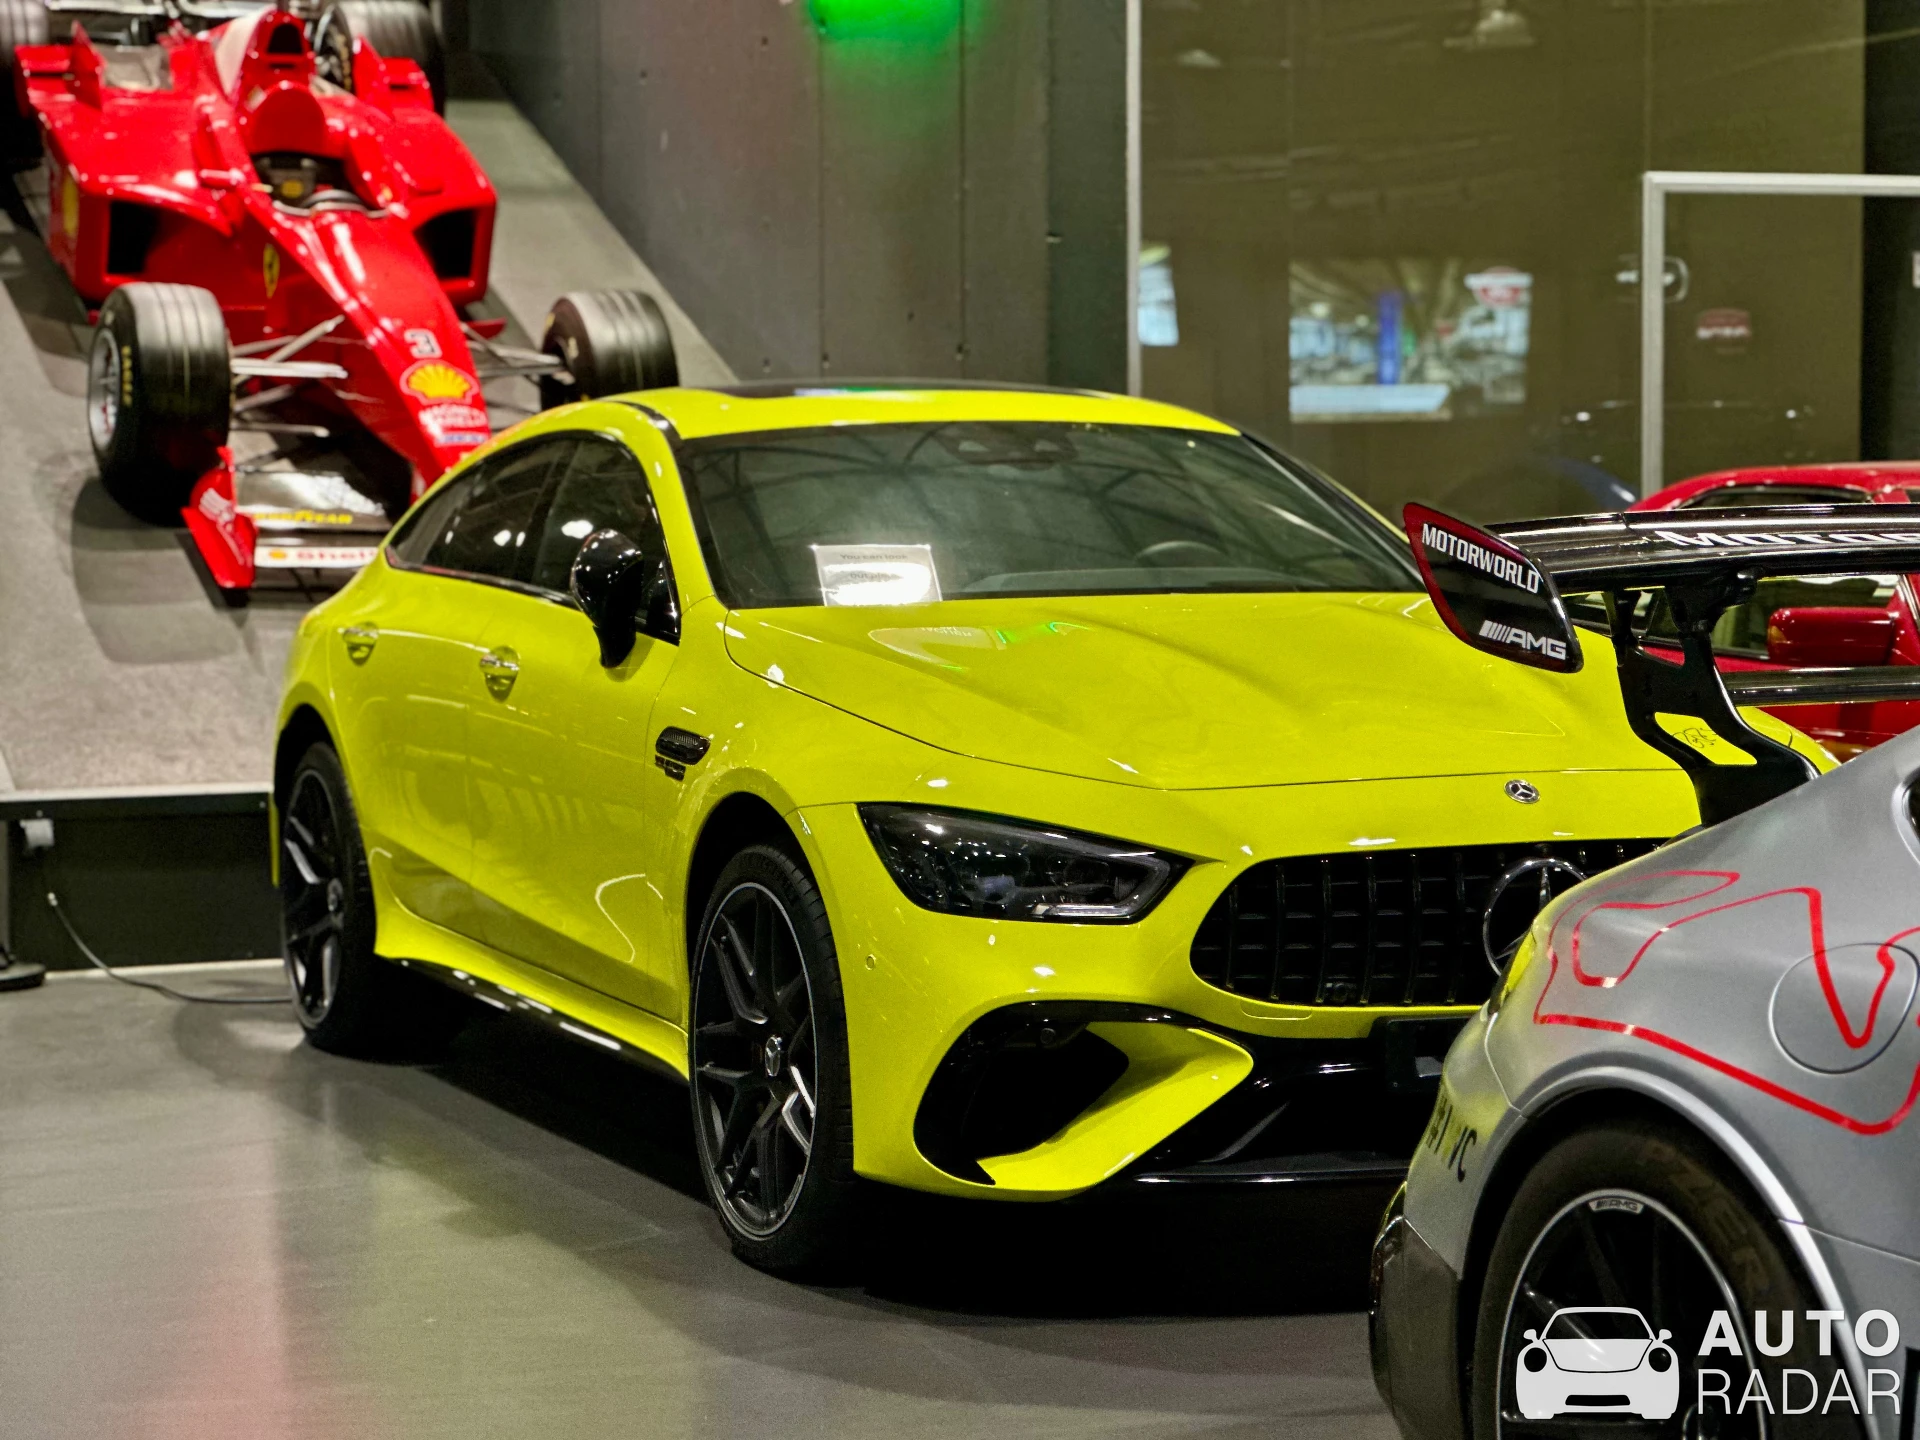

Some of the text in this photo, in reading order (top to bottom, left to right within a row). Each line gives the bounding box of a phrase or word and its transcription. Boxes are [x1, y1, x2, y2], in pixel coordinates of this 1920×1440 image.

[404, 329, 443, 359] 3
[1421, 523, 1540, 594] MOTORWORLD
[1505, 626, 1567, 661] AMG
